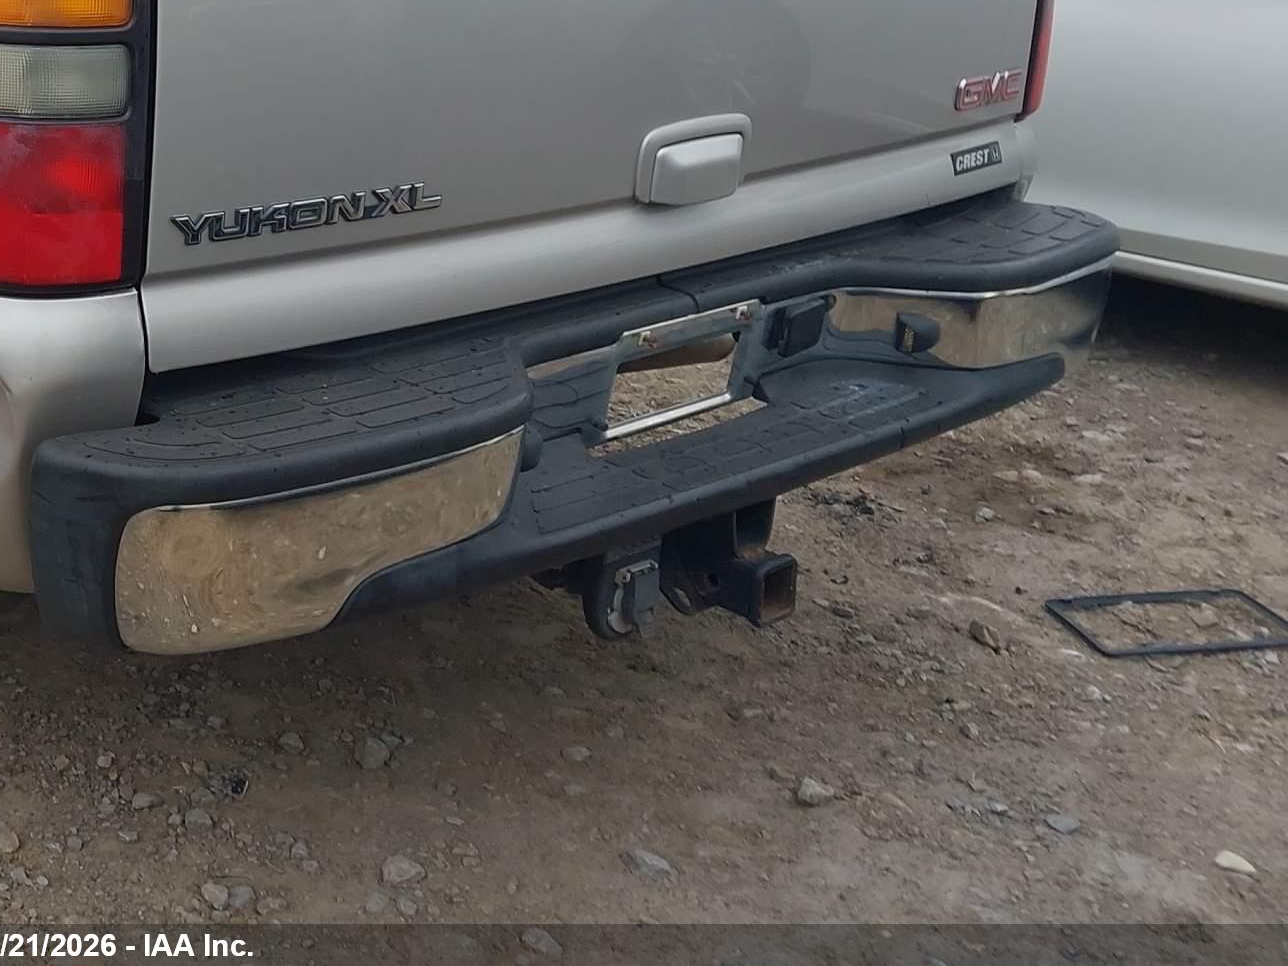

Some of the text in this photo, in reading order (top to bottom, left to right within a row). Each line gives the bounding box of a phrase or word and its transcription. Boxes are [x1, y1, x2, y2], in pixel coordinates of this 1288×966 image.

[954, 68, 1021, 111] GMC
[955, 147, 990, 172] CREST
[171, 181, 442, 245] YUKON XL
